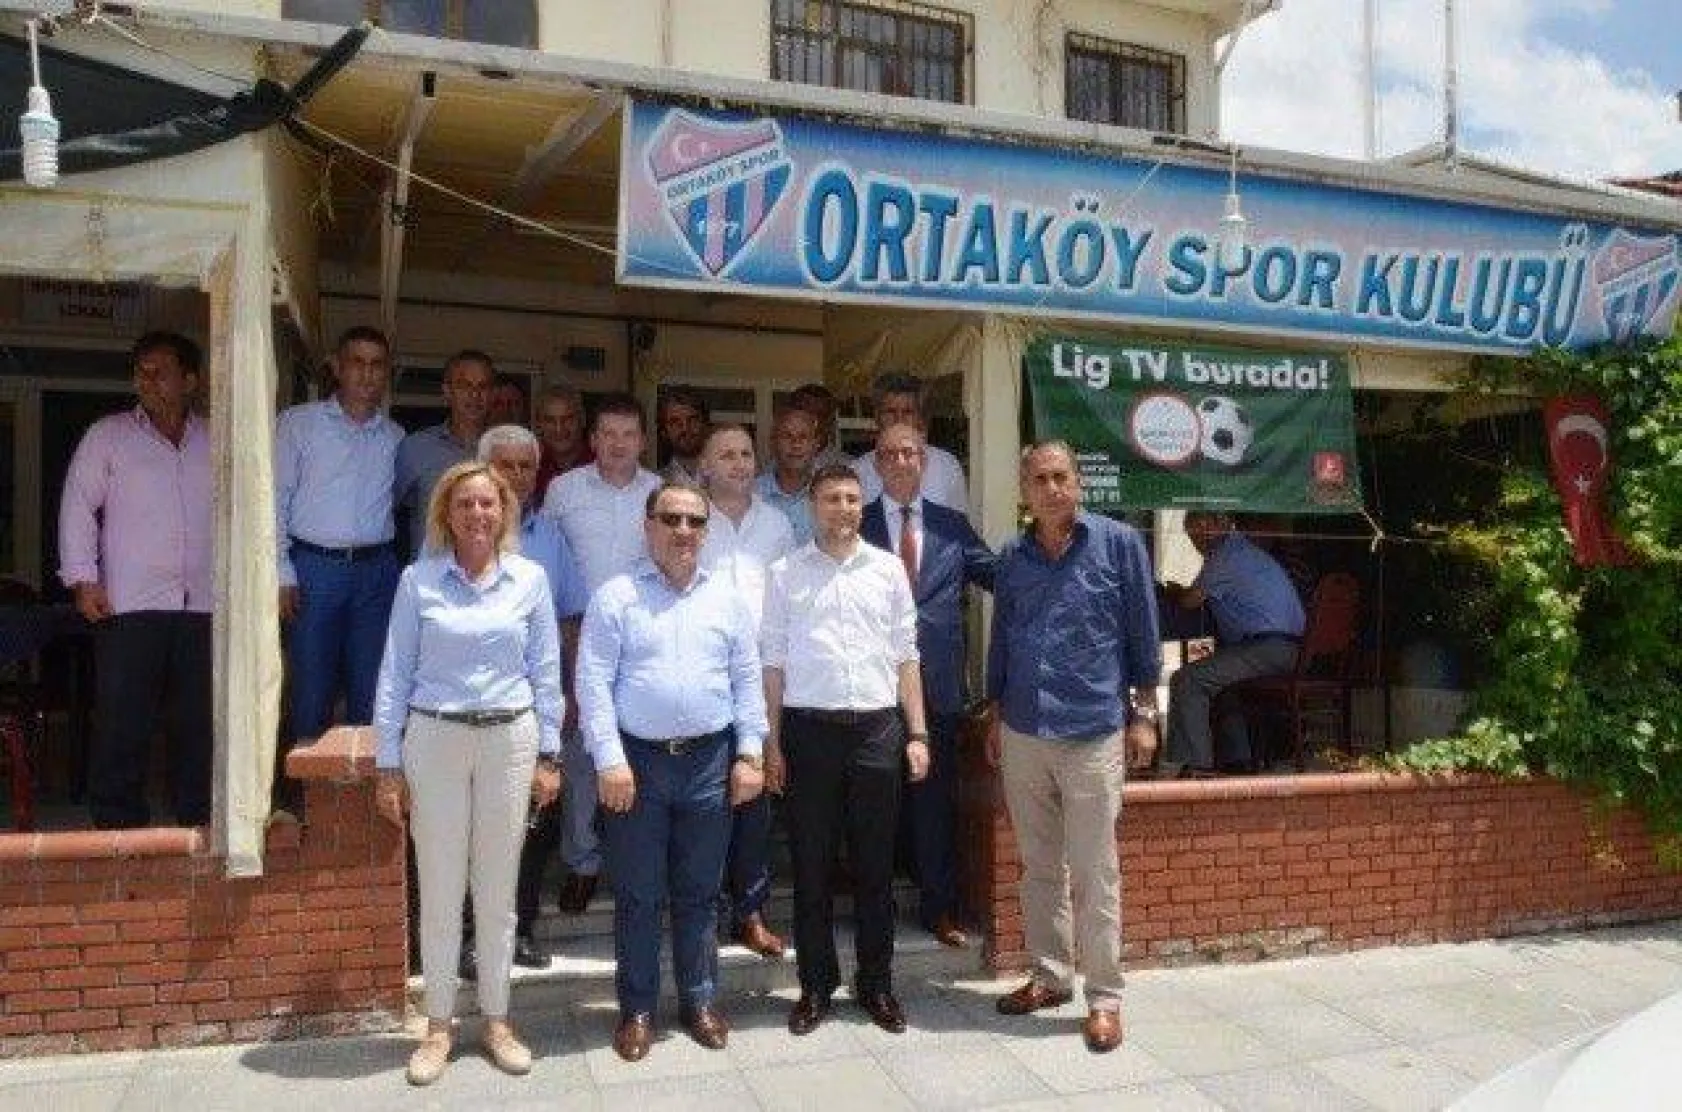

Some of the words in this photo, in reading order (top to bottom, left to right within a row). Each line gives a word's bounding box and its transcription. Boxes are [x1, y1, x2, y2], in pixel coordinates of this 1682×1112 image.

[802, 167, 1154, 290] ORTAKÖY
[1164, 234, 1342, 309] SPOR
[1355, 224, 1588, 348] KULUBÜ
[1052, 343, 1110, 389] Lig
[1121, 349, 1168, 381] TV
[1182, 351, 1330, 390] burada!
